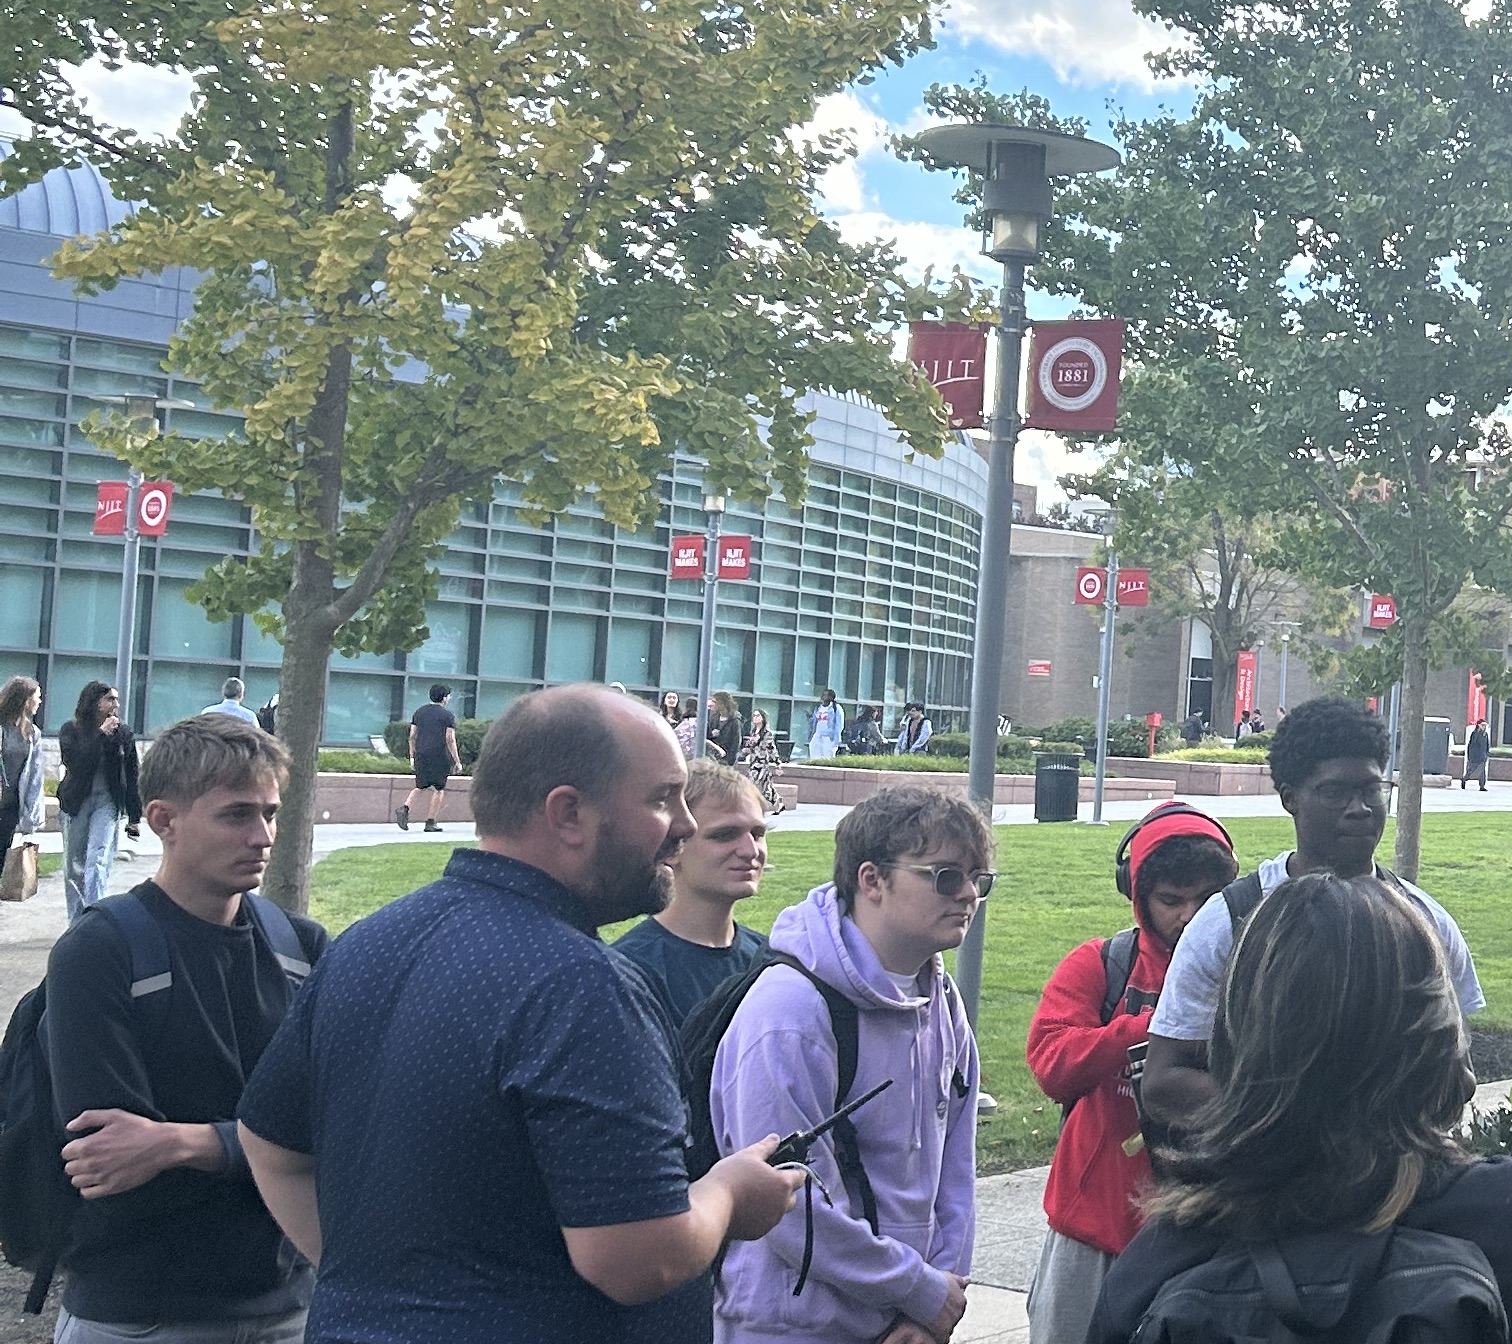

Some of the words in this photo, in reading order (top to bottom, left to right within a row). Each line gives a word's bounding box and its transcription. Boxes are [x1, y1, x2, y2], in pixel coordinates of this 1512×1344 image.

[1058, 369, 1088, 382] 1881
[97, 500, 122, 512] NJIT
[1119, 580, 1145, 590] NJIT
